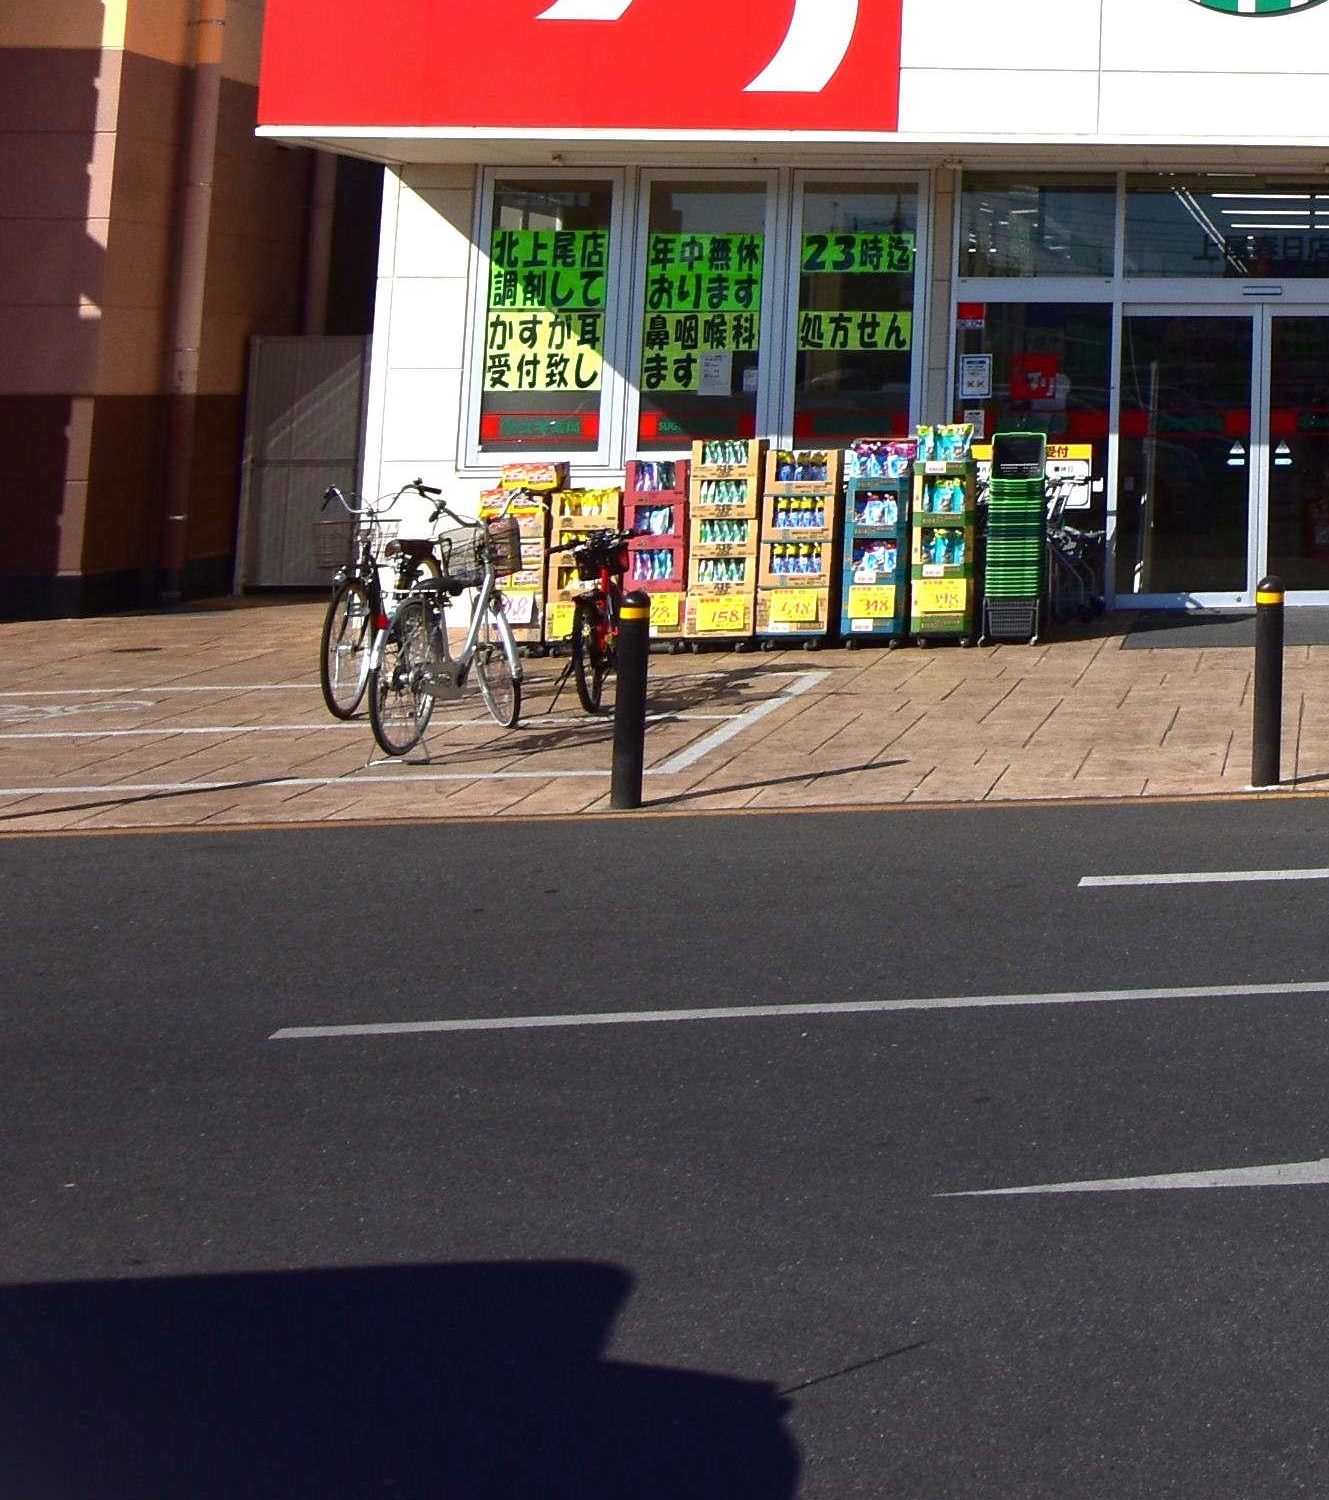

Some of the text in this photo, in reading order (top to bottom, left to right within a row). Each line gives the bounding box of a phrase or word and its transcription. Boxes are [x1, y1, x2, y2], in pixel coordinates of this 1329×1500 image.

[494, 231, 607, 269] 北上尾店
[651, 235, 759, 272] 年中無休
[492, 270, 604, 308] 調剤して
[648, 273, 758, 310] おります
[489, 313, 600, 351] かすが耳
[645, 313, 755, 351] 鼻咽喉科
[800, 312, 907, 350] 処方せん
[487, 352, 599, 389] 受付致し
[644, 352, 698, 389] ます
[711, 610, 740, 623] 158
